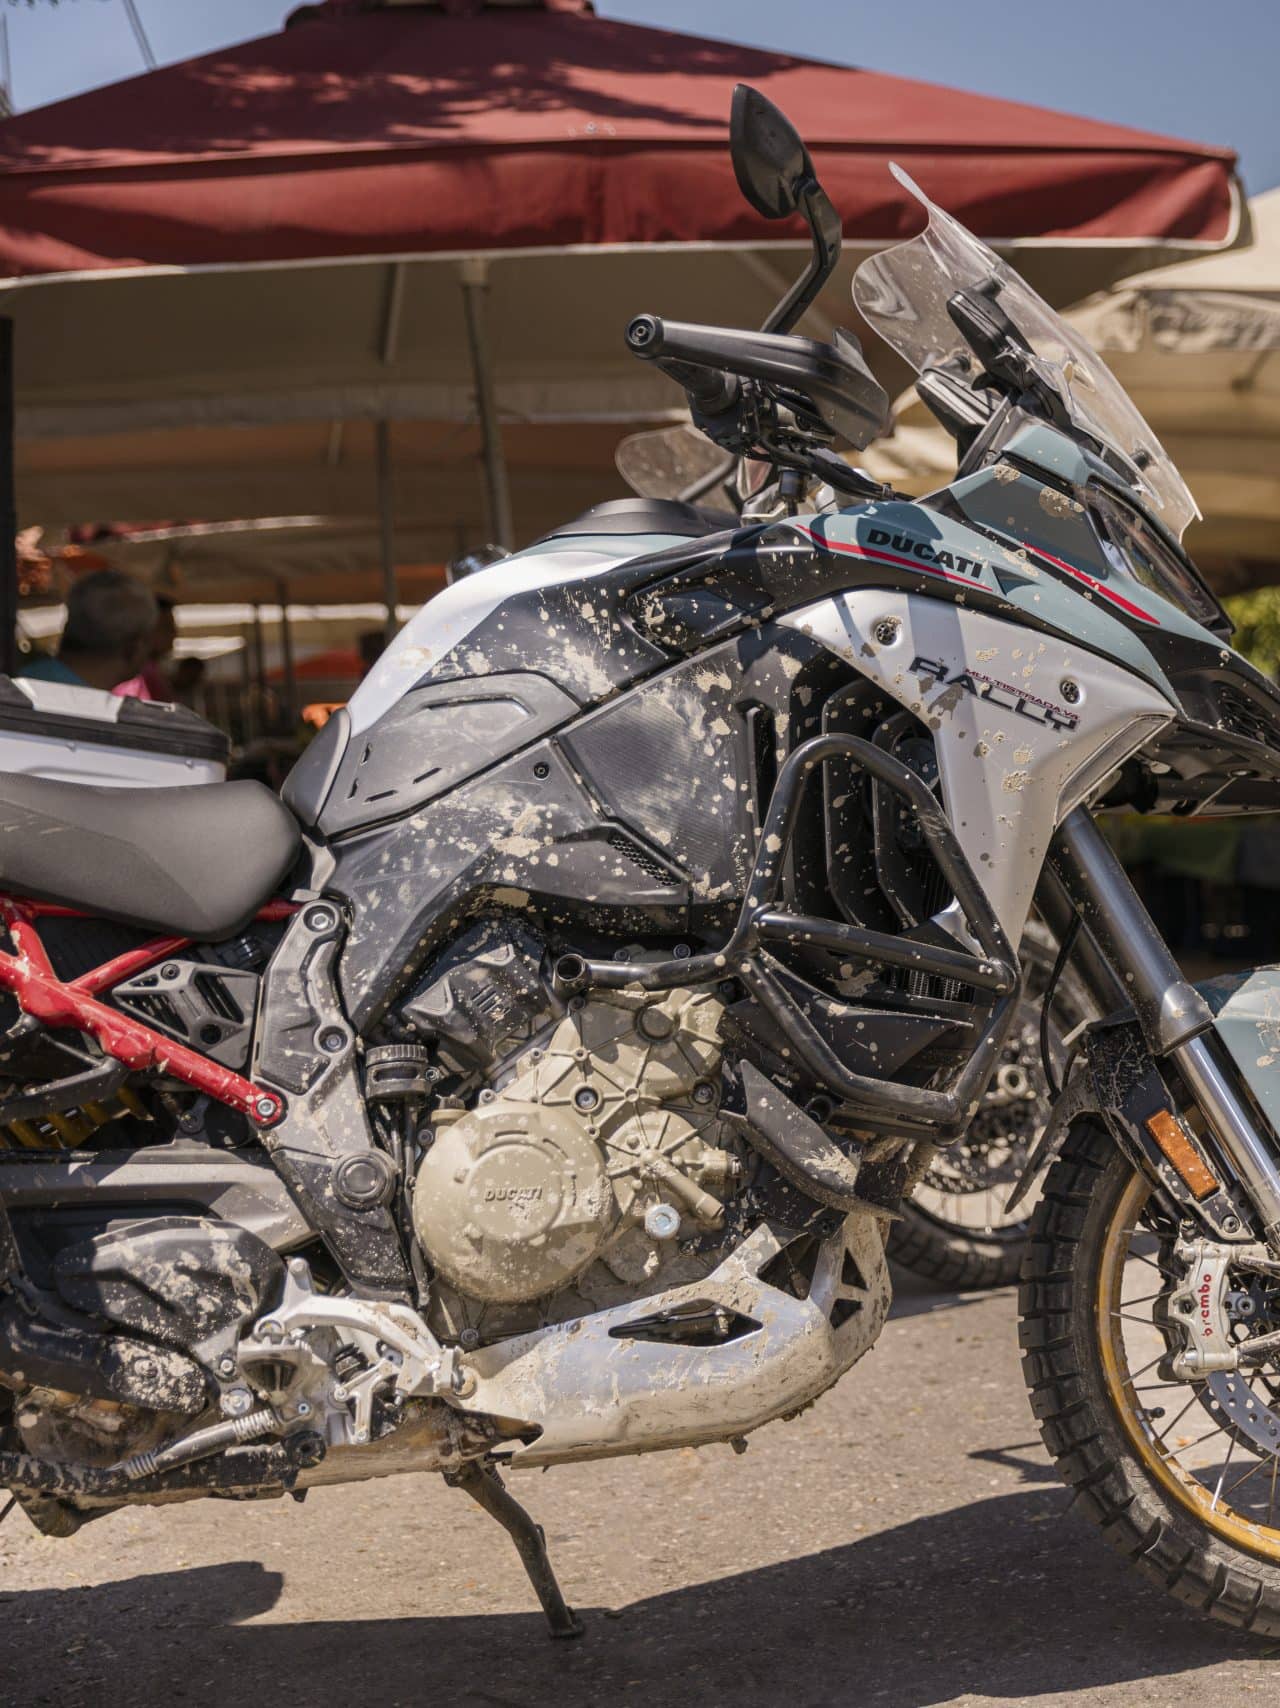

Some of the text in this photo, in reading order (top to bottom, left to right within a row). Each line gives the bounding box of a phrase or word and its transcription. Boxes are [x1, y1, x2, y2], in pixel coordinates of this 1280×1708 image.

[866, 528, 984, 579] DUCATI
[909, 656, 1077, 731] RALLY
[964, 667, 1061, 714] MULTISTRADA
[484, 1186, 543, 1203] DUCATI
[1198, 1273, 1214, 1337] brembo
